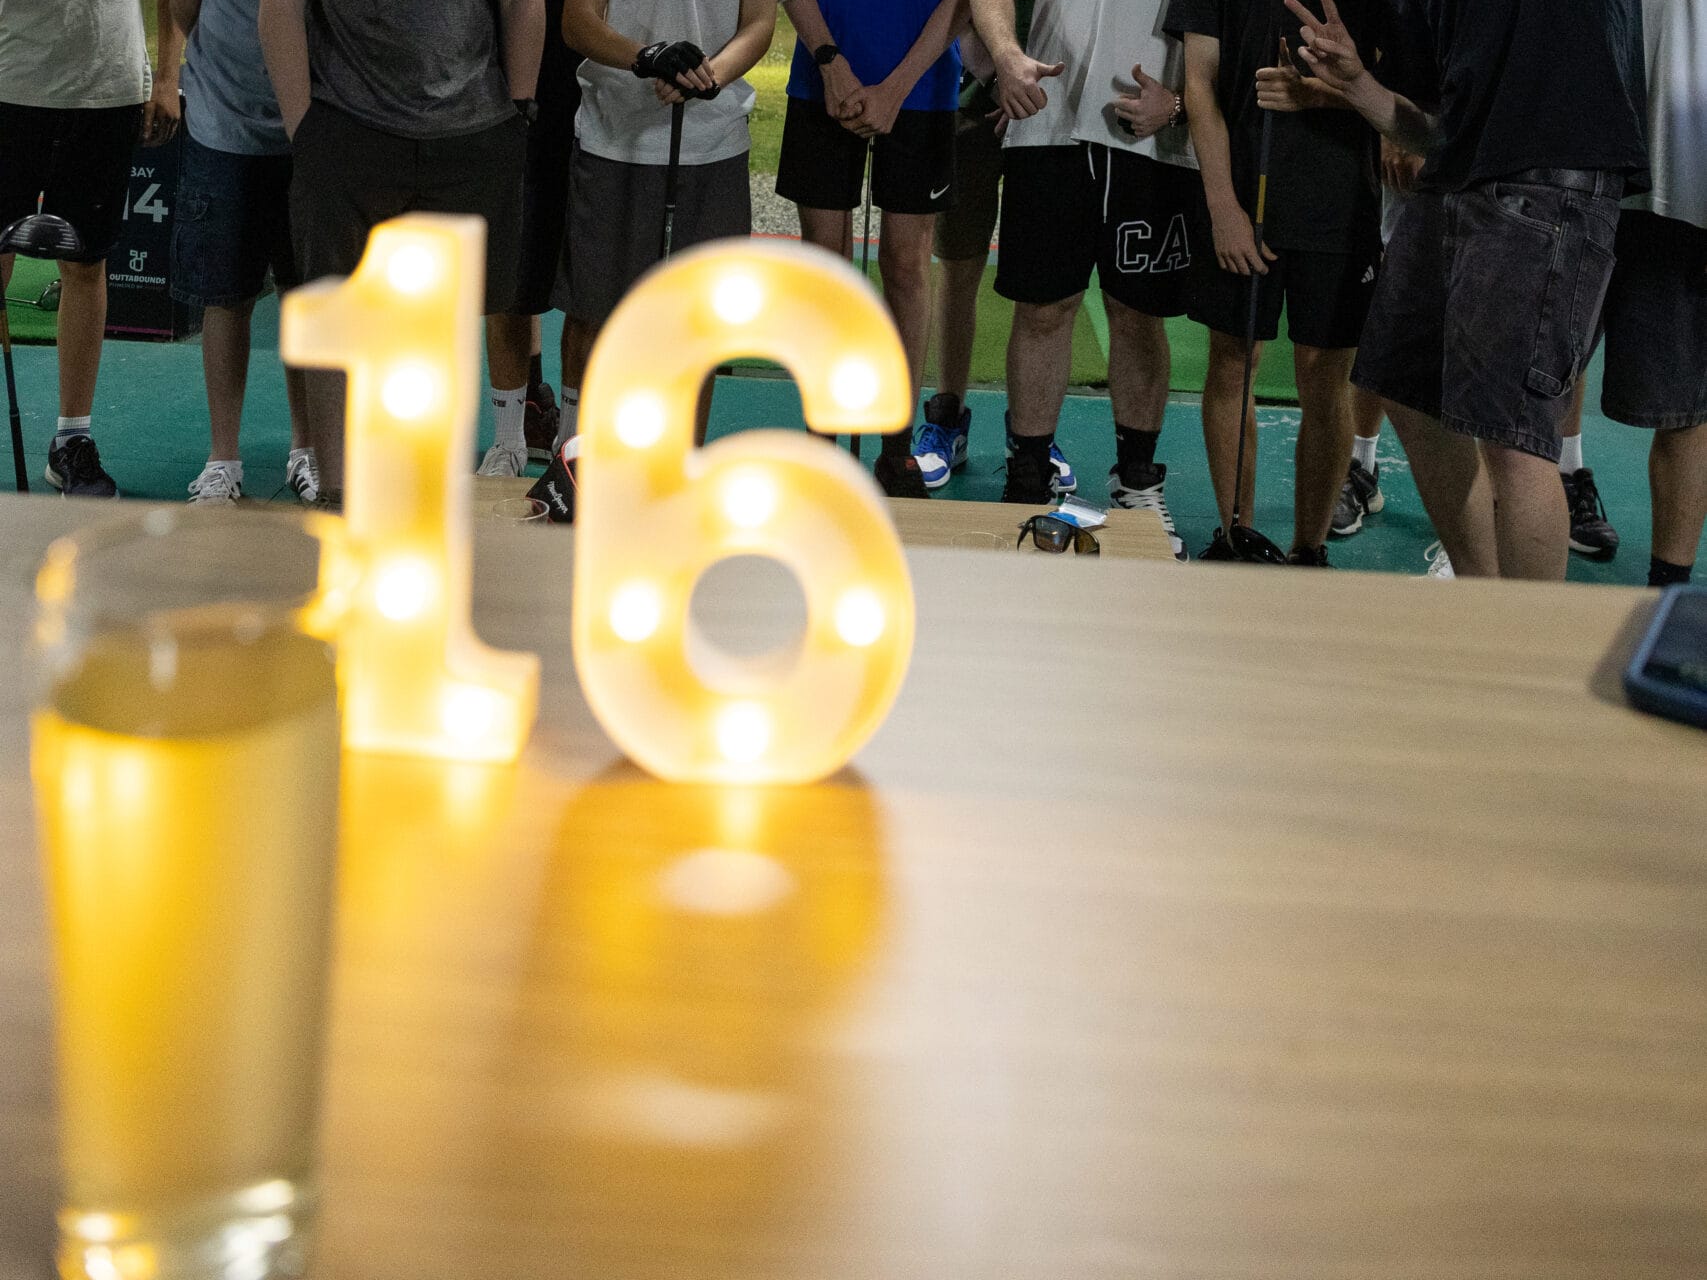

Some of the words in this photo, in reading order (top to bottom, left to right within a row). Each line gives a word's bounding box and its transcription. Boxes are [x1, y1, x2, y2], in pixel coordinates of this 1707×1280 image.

[1116, 213, 1192, 273] CA
[109, 273, 166, 285] OUTTABOUNDS
[280, 212, 916, 786] 16
